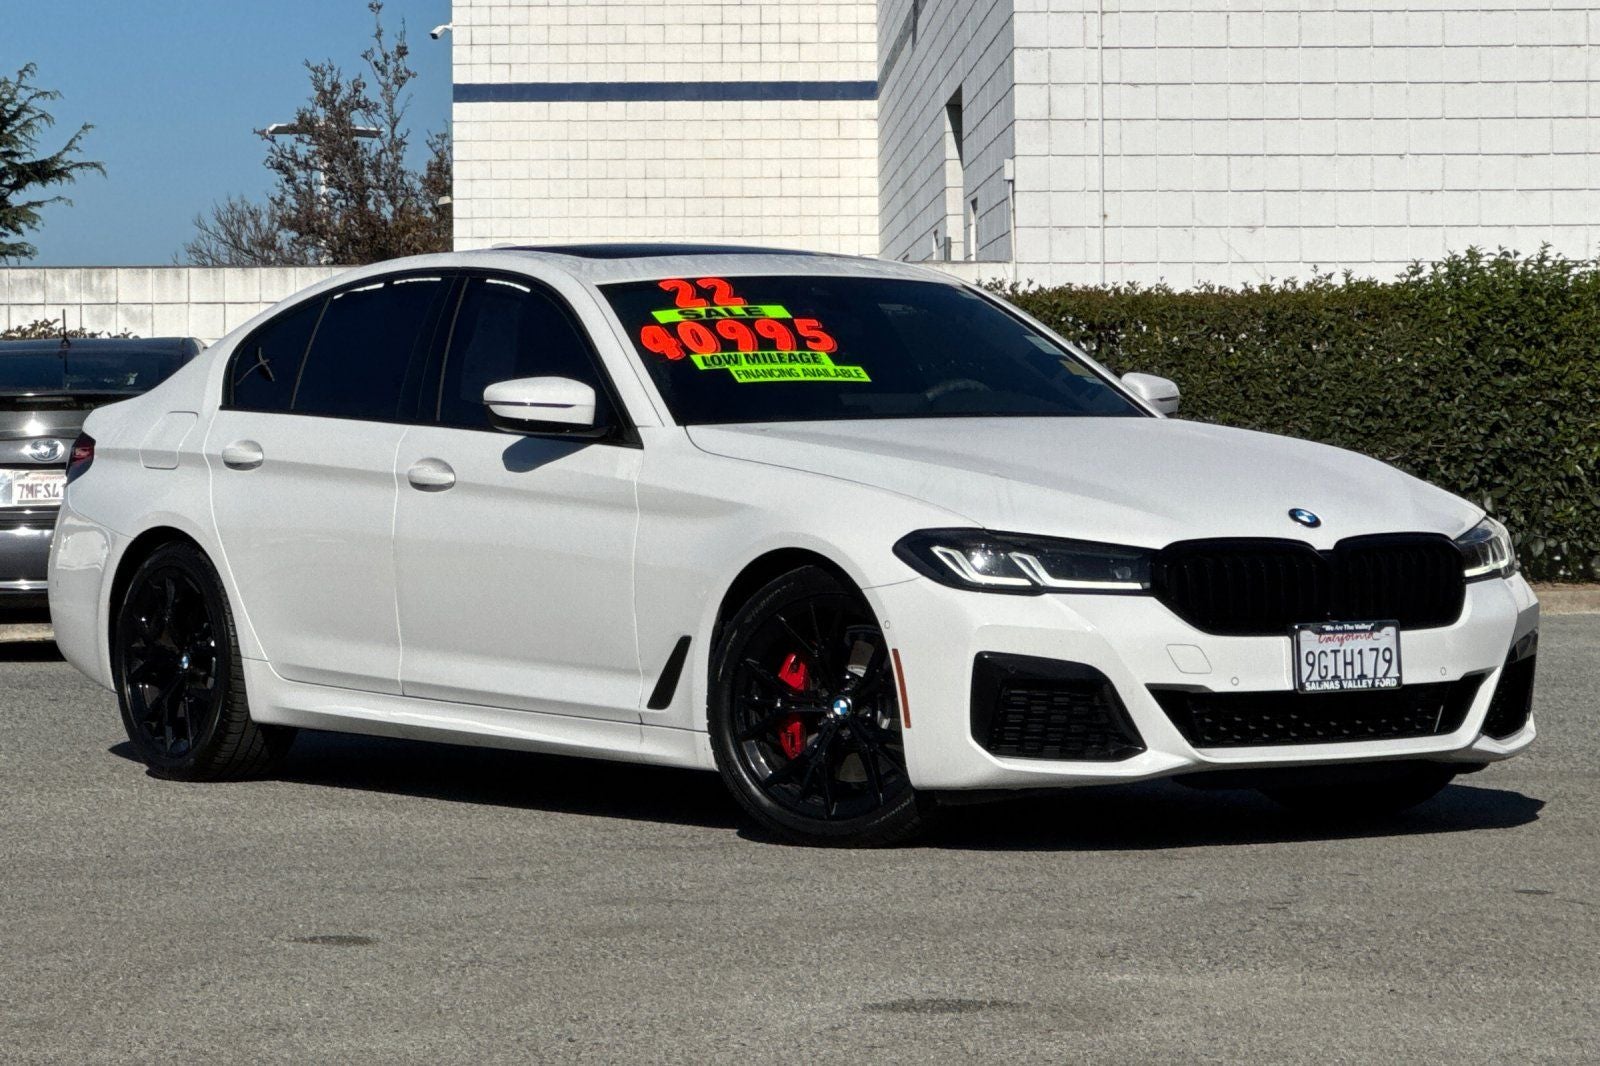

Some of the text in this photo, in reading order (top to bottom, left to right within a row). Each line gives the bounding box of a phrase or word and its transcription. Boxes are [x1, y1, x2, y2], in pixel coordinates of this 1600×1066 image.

[658, 277, 747, 308] 22
[678, 307, 766, 319] SALE
[640, 318, 837, 360] 40995
[702, 352, 824, 367] LOW MILEAGE
[735, 367, 865, 379] FINANCING AVAILABLE
[1305, 647, 1393, 681] 9GIH179
[1305, 677, 1397, 691] SALINAS VALLEY FORD
